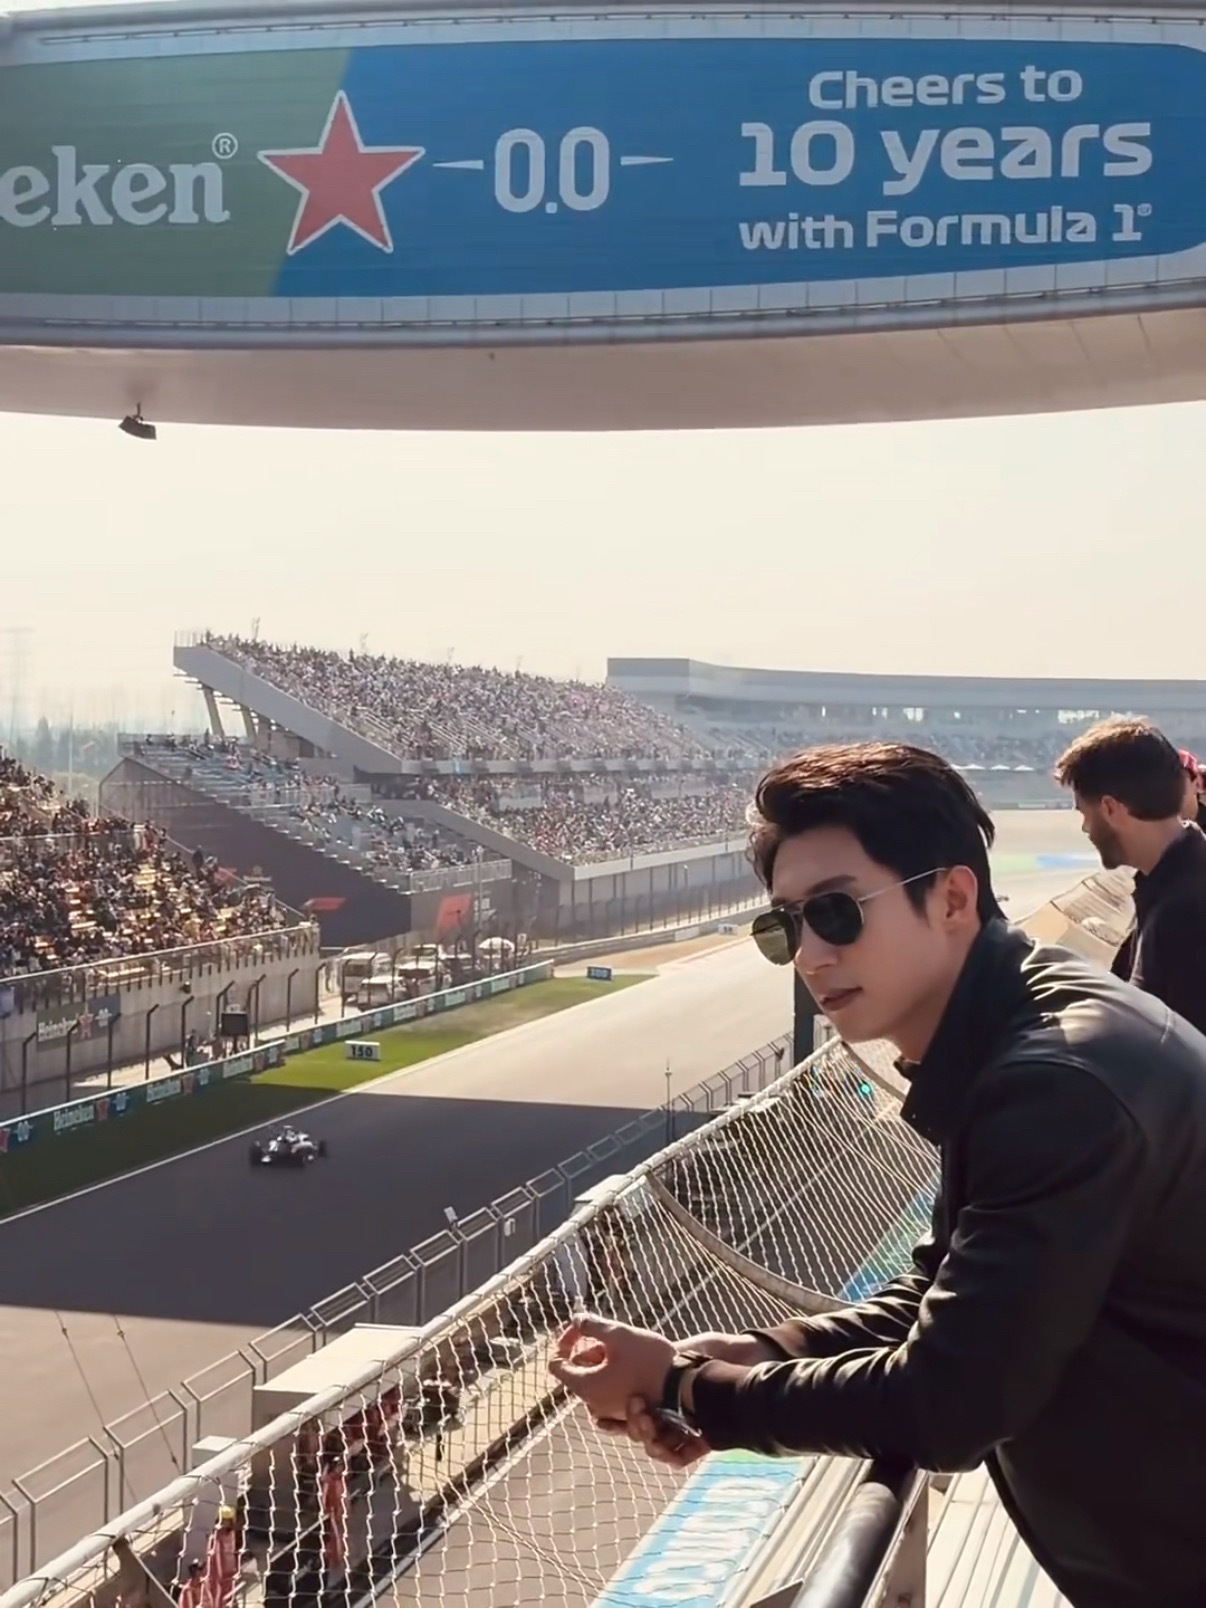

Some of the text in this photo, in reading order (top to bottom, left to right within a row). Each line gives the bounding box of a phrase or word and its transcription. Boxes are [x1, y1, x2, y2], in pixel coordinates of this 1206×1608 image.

[809, 66, 1083, 109] Cheers to
[494, 126, 610, 213] 0.0
[739, 120, 1153, 195] 10 years
[739, 212, 854, 250] with
[866, 206, 1097, 248] Formula
[351, 1044, 373, 1057] 150
